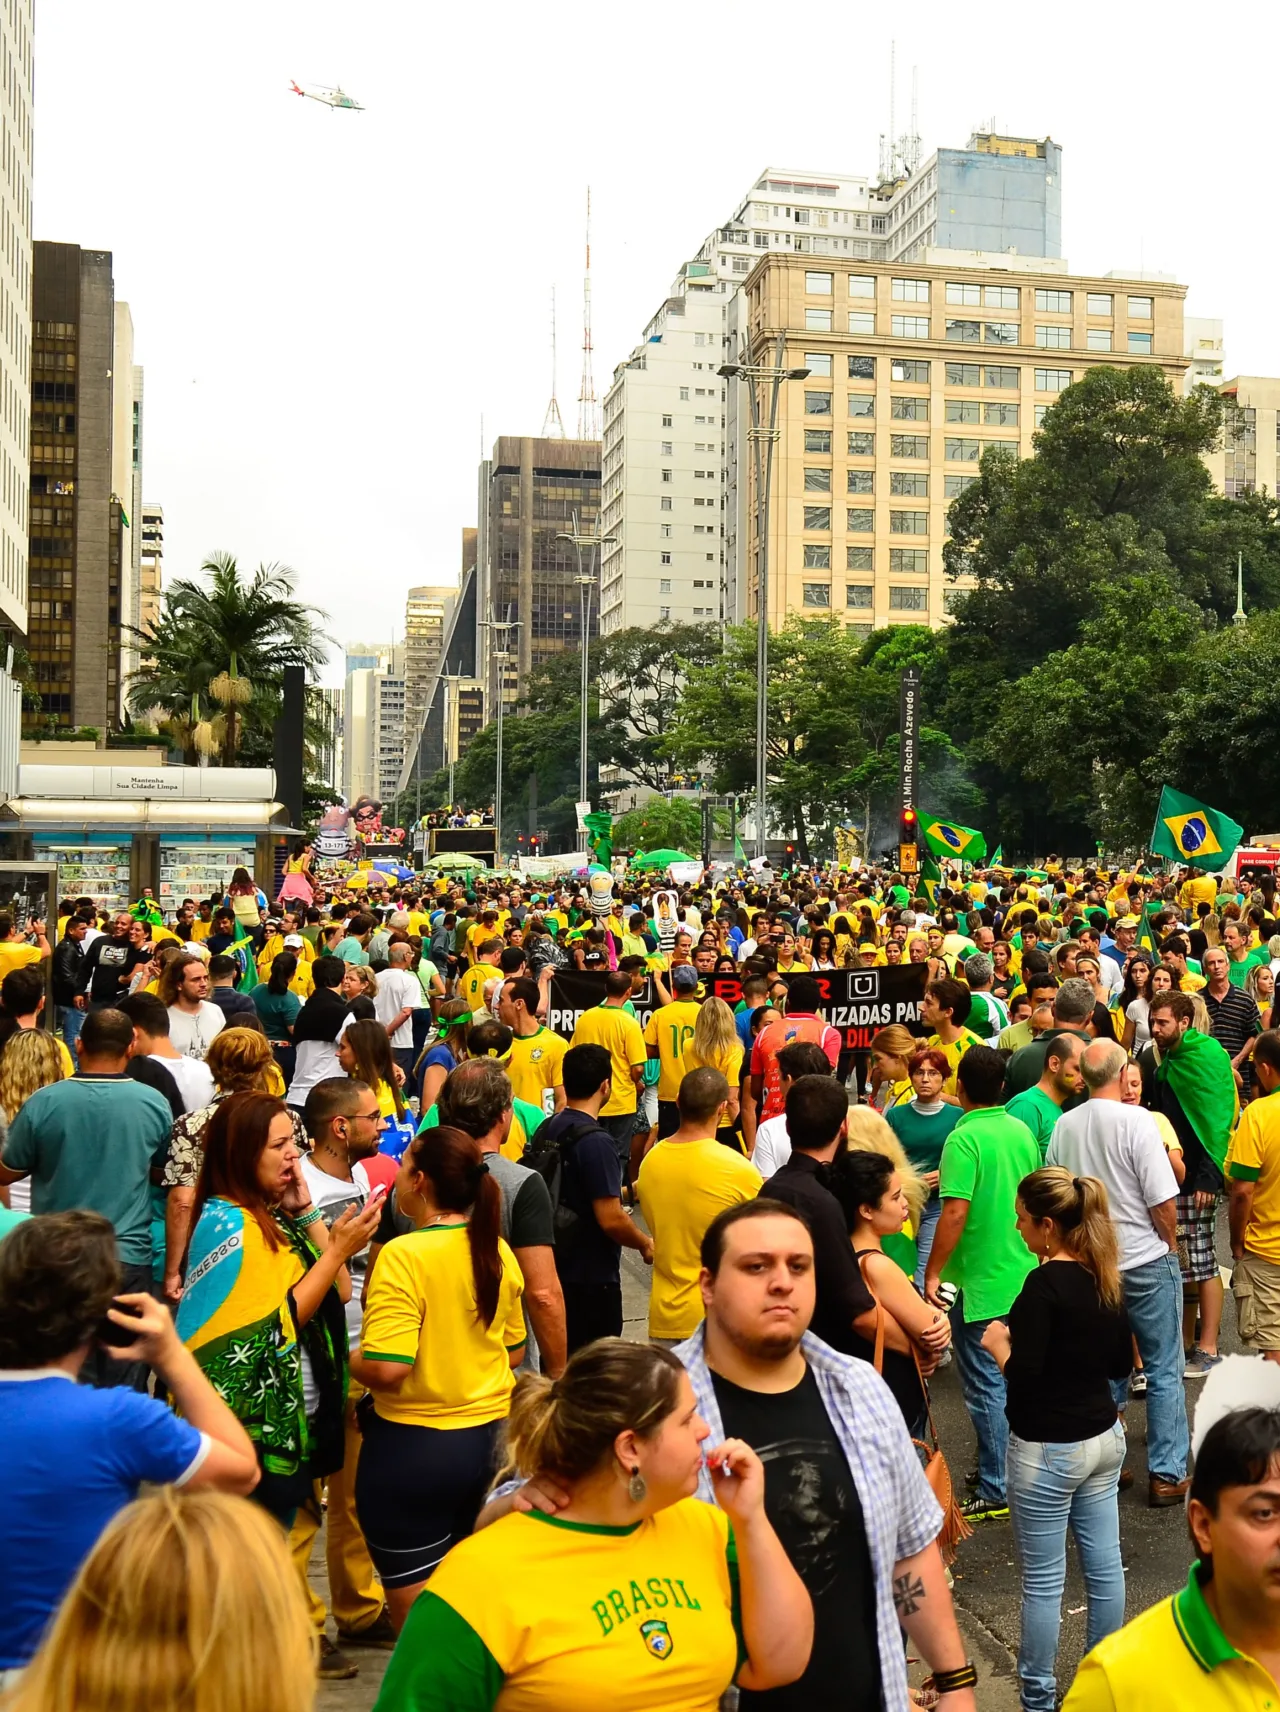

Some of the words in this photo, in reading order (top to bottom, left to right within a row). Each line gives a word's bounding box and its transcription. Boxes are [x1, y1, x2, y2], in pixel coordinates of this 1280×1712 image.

[904, 690, 914, 736] Azevedo
[904, 740, 913, 772] Rocha
[903, 773, 912, 795] Min.
[822, 1004, 891, 1026] LIZADAS
[591, 1578, 702, 1637] BRASIL
